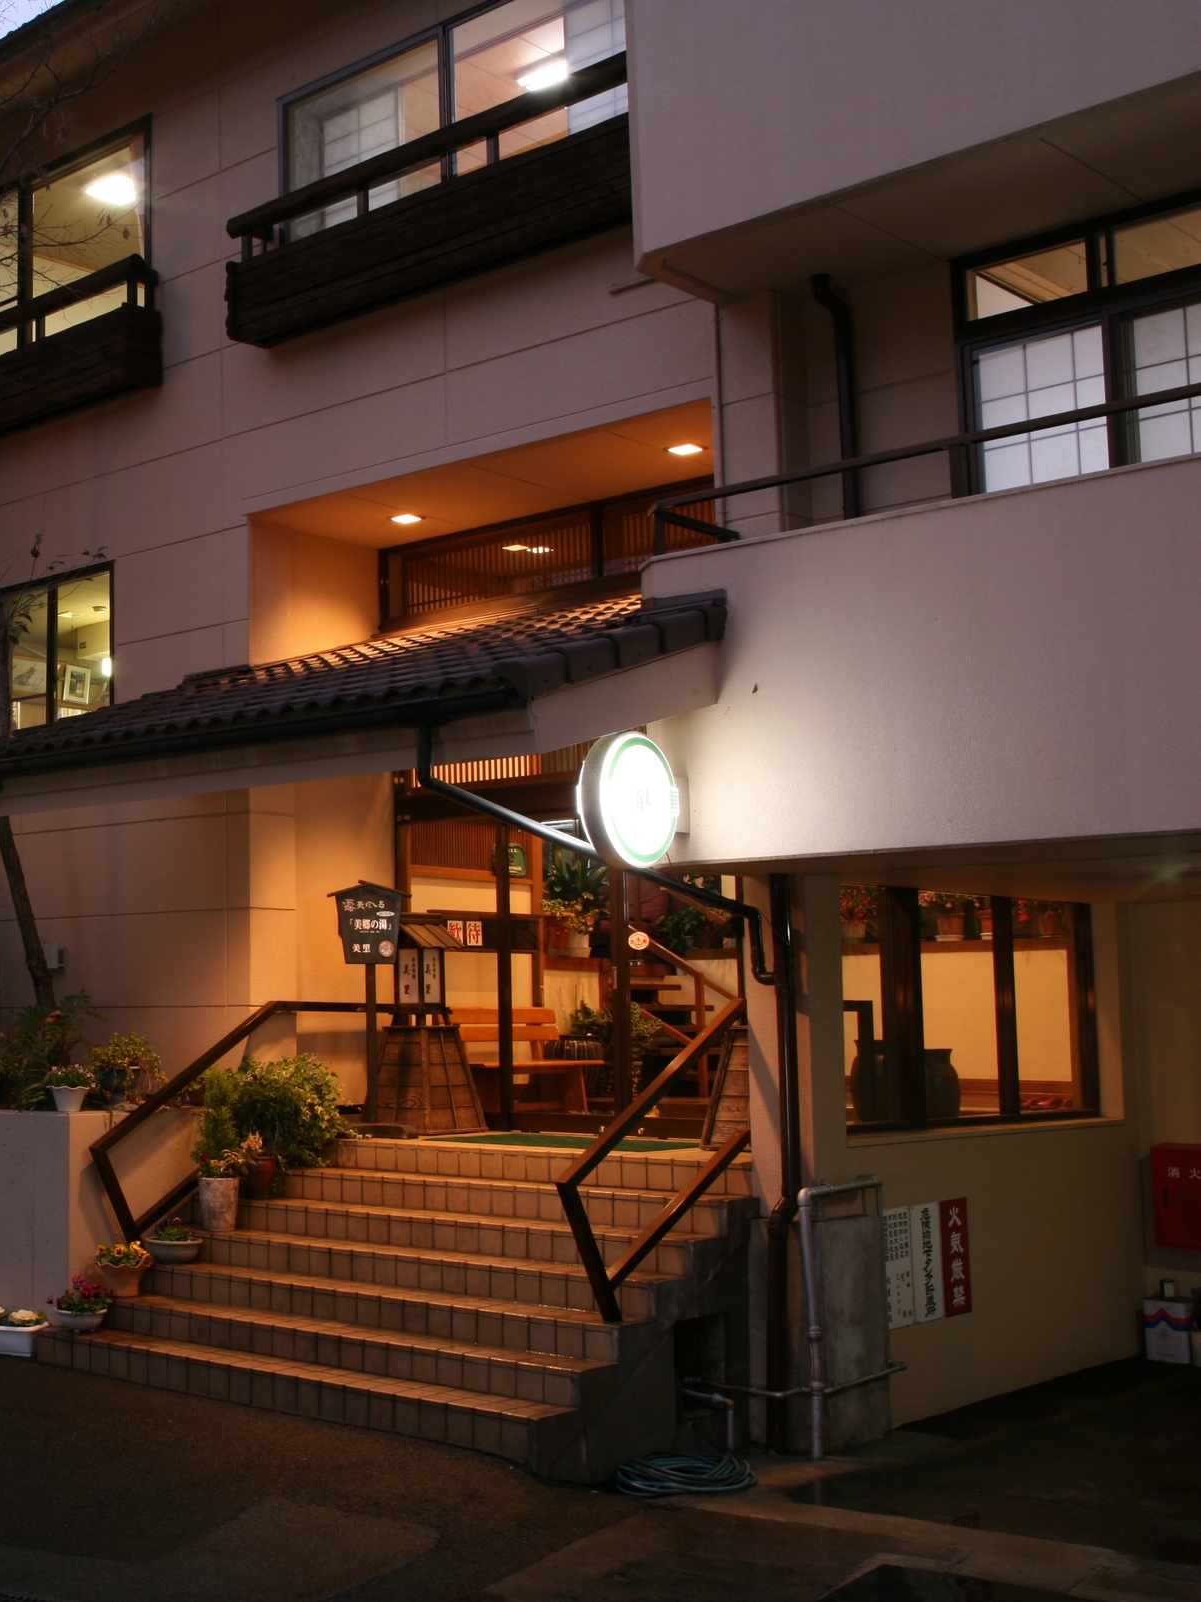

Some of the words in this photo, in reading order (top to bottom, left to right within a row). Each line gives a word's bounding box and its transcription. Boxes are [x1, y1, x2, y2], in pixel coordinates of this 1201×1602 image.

[352, 943, 371, 953] 美里
[920, 1207, 936, 1318] 危険物地下タンク貯蔵所
[948, 1205, 966, 1308] 火気厳禁
